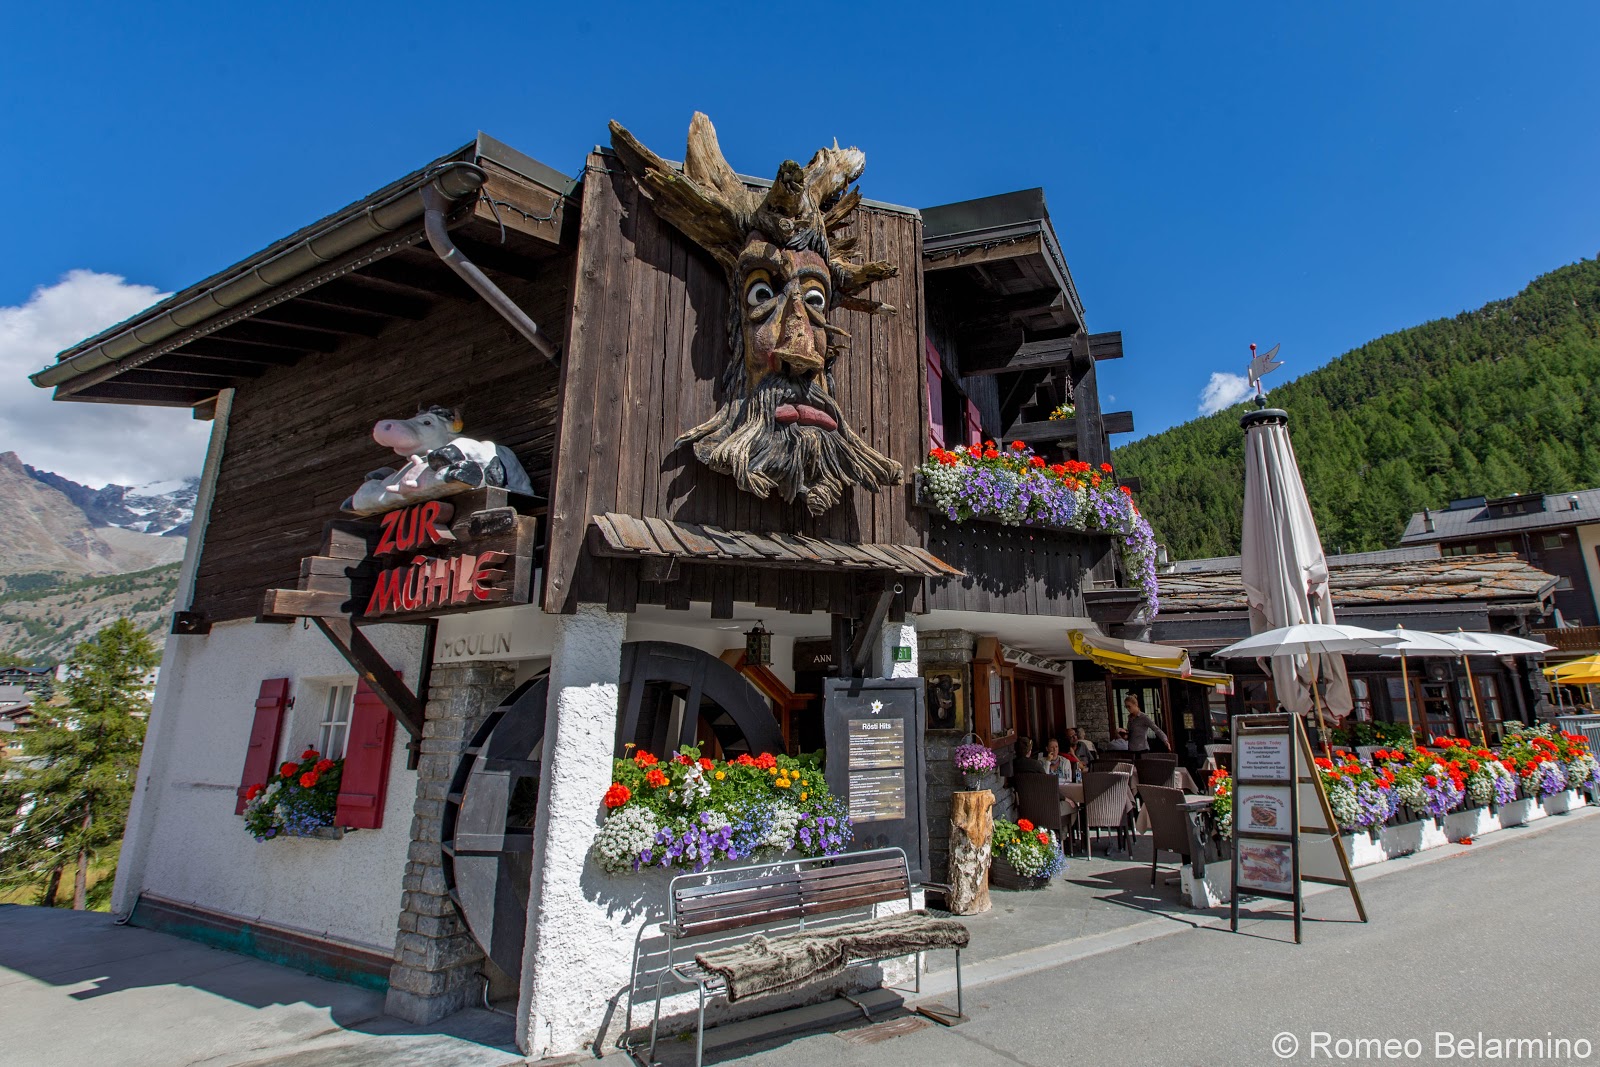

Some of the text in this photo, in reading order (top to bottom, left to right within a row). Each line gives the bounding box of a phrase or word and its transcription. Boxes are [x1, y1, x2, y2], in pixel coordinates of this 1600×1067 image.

[373, 501, 454, 557] ZUR
[364, 550, 509, 617] MÜHLE
[440, 632, 512, 658] MOULIN
[862, 722, 892, 730] Rösti Hits
